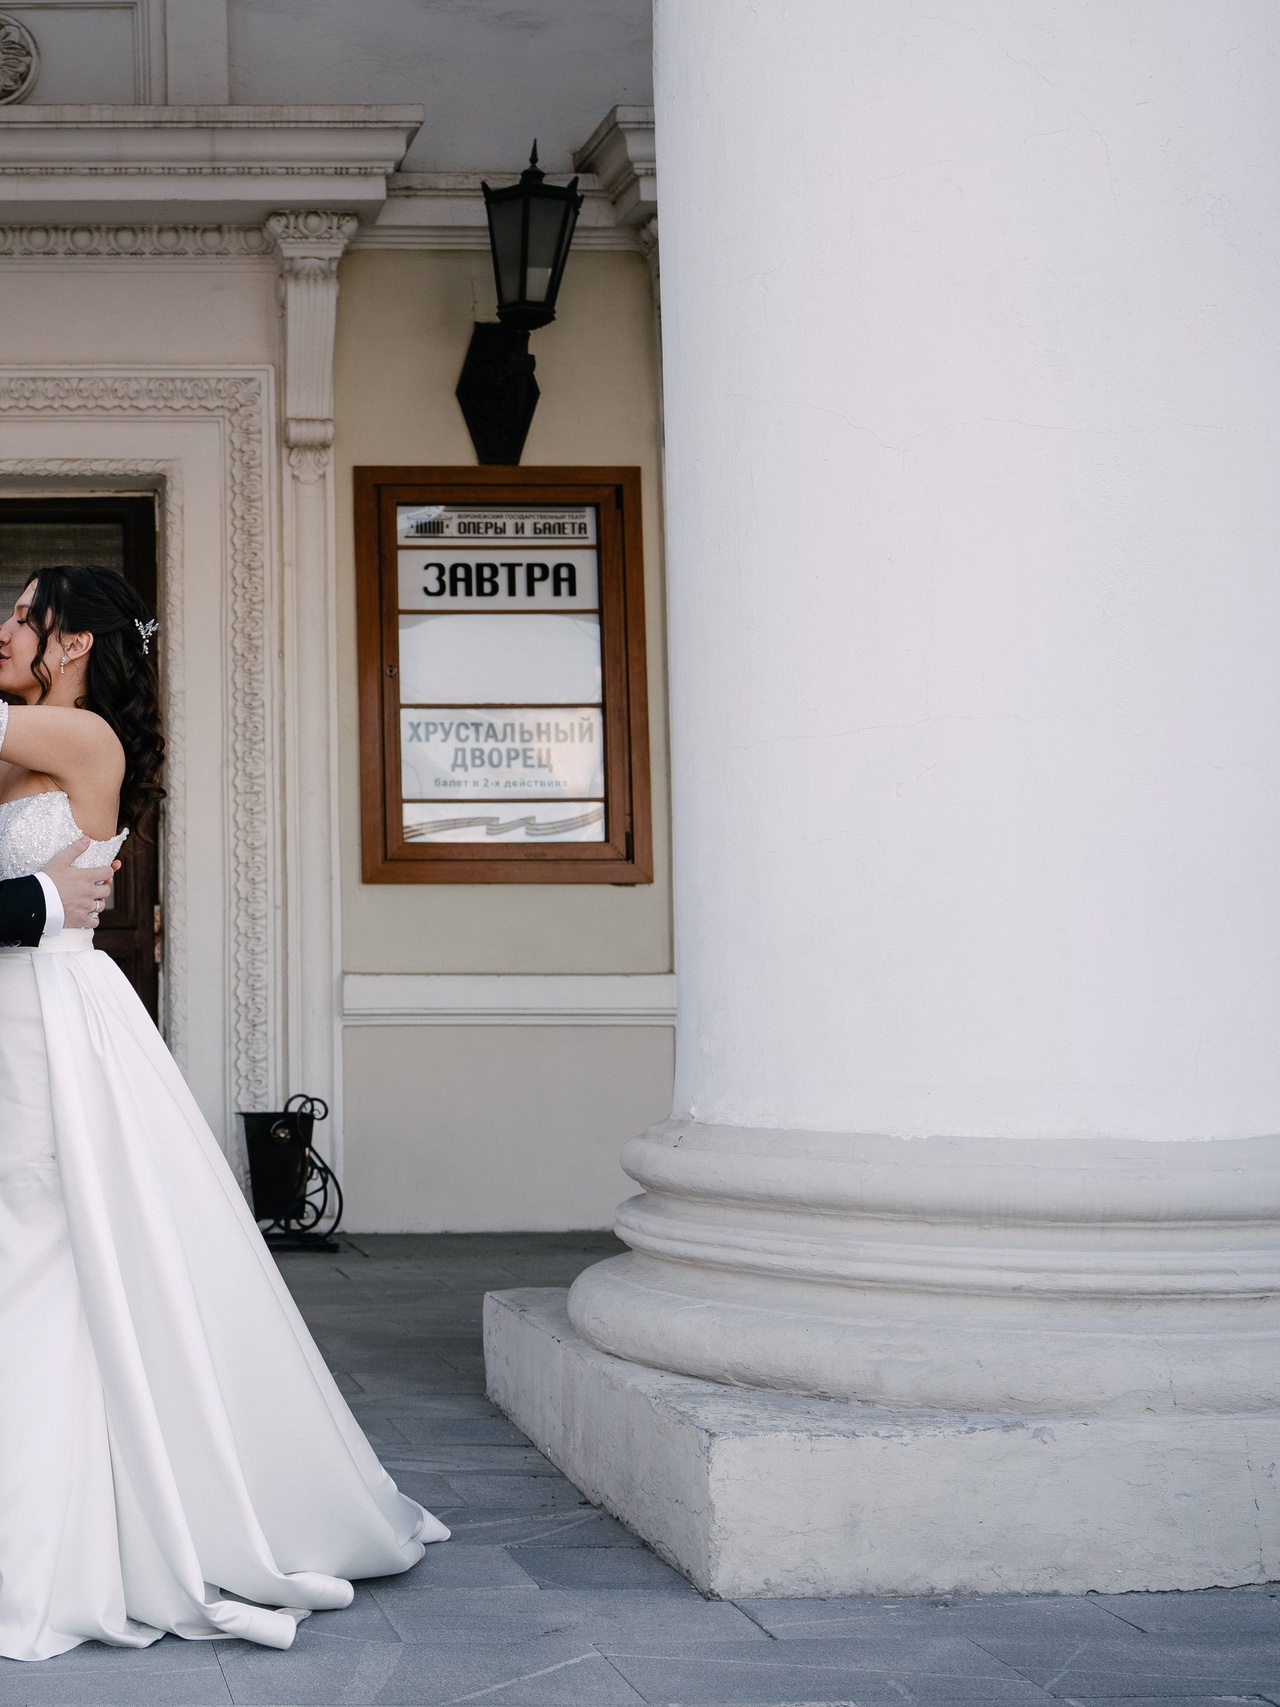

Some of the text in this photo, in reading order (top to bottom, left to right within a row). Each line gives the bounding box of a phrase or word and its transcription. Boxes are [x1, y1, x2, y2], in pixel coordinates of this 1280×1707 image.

[458, 521, 587, 535] ОПЕРЫ И БАЛЕТА
[423, 562, 577, 597] ЗАВТРА
[408, 717, 595, 743] ХРУСТАЛЬНЫЙ
[450, 747, 554, 773] ДВОРЕЦ
[434, 777, 569, 789] балет в 2-х действиях
